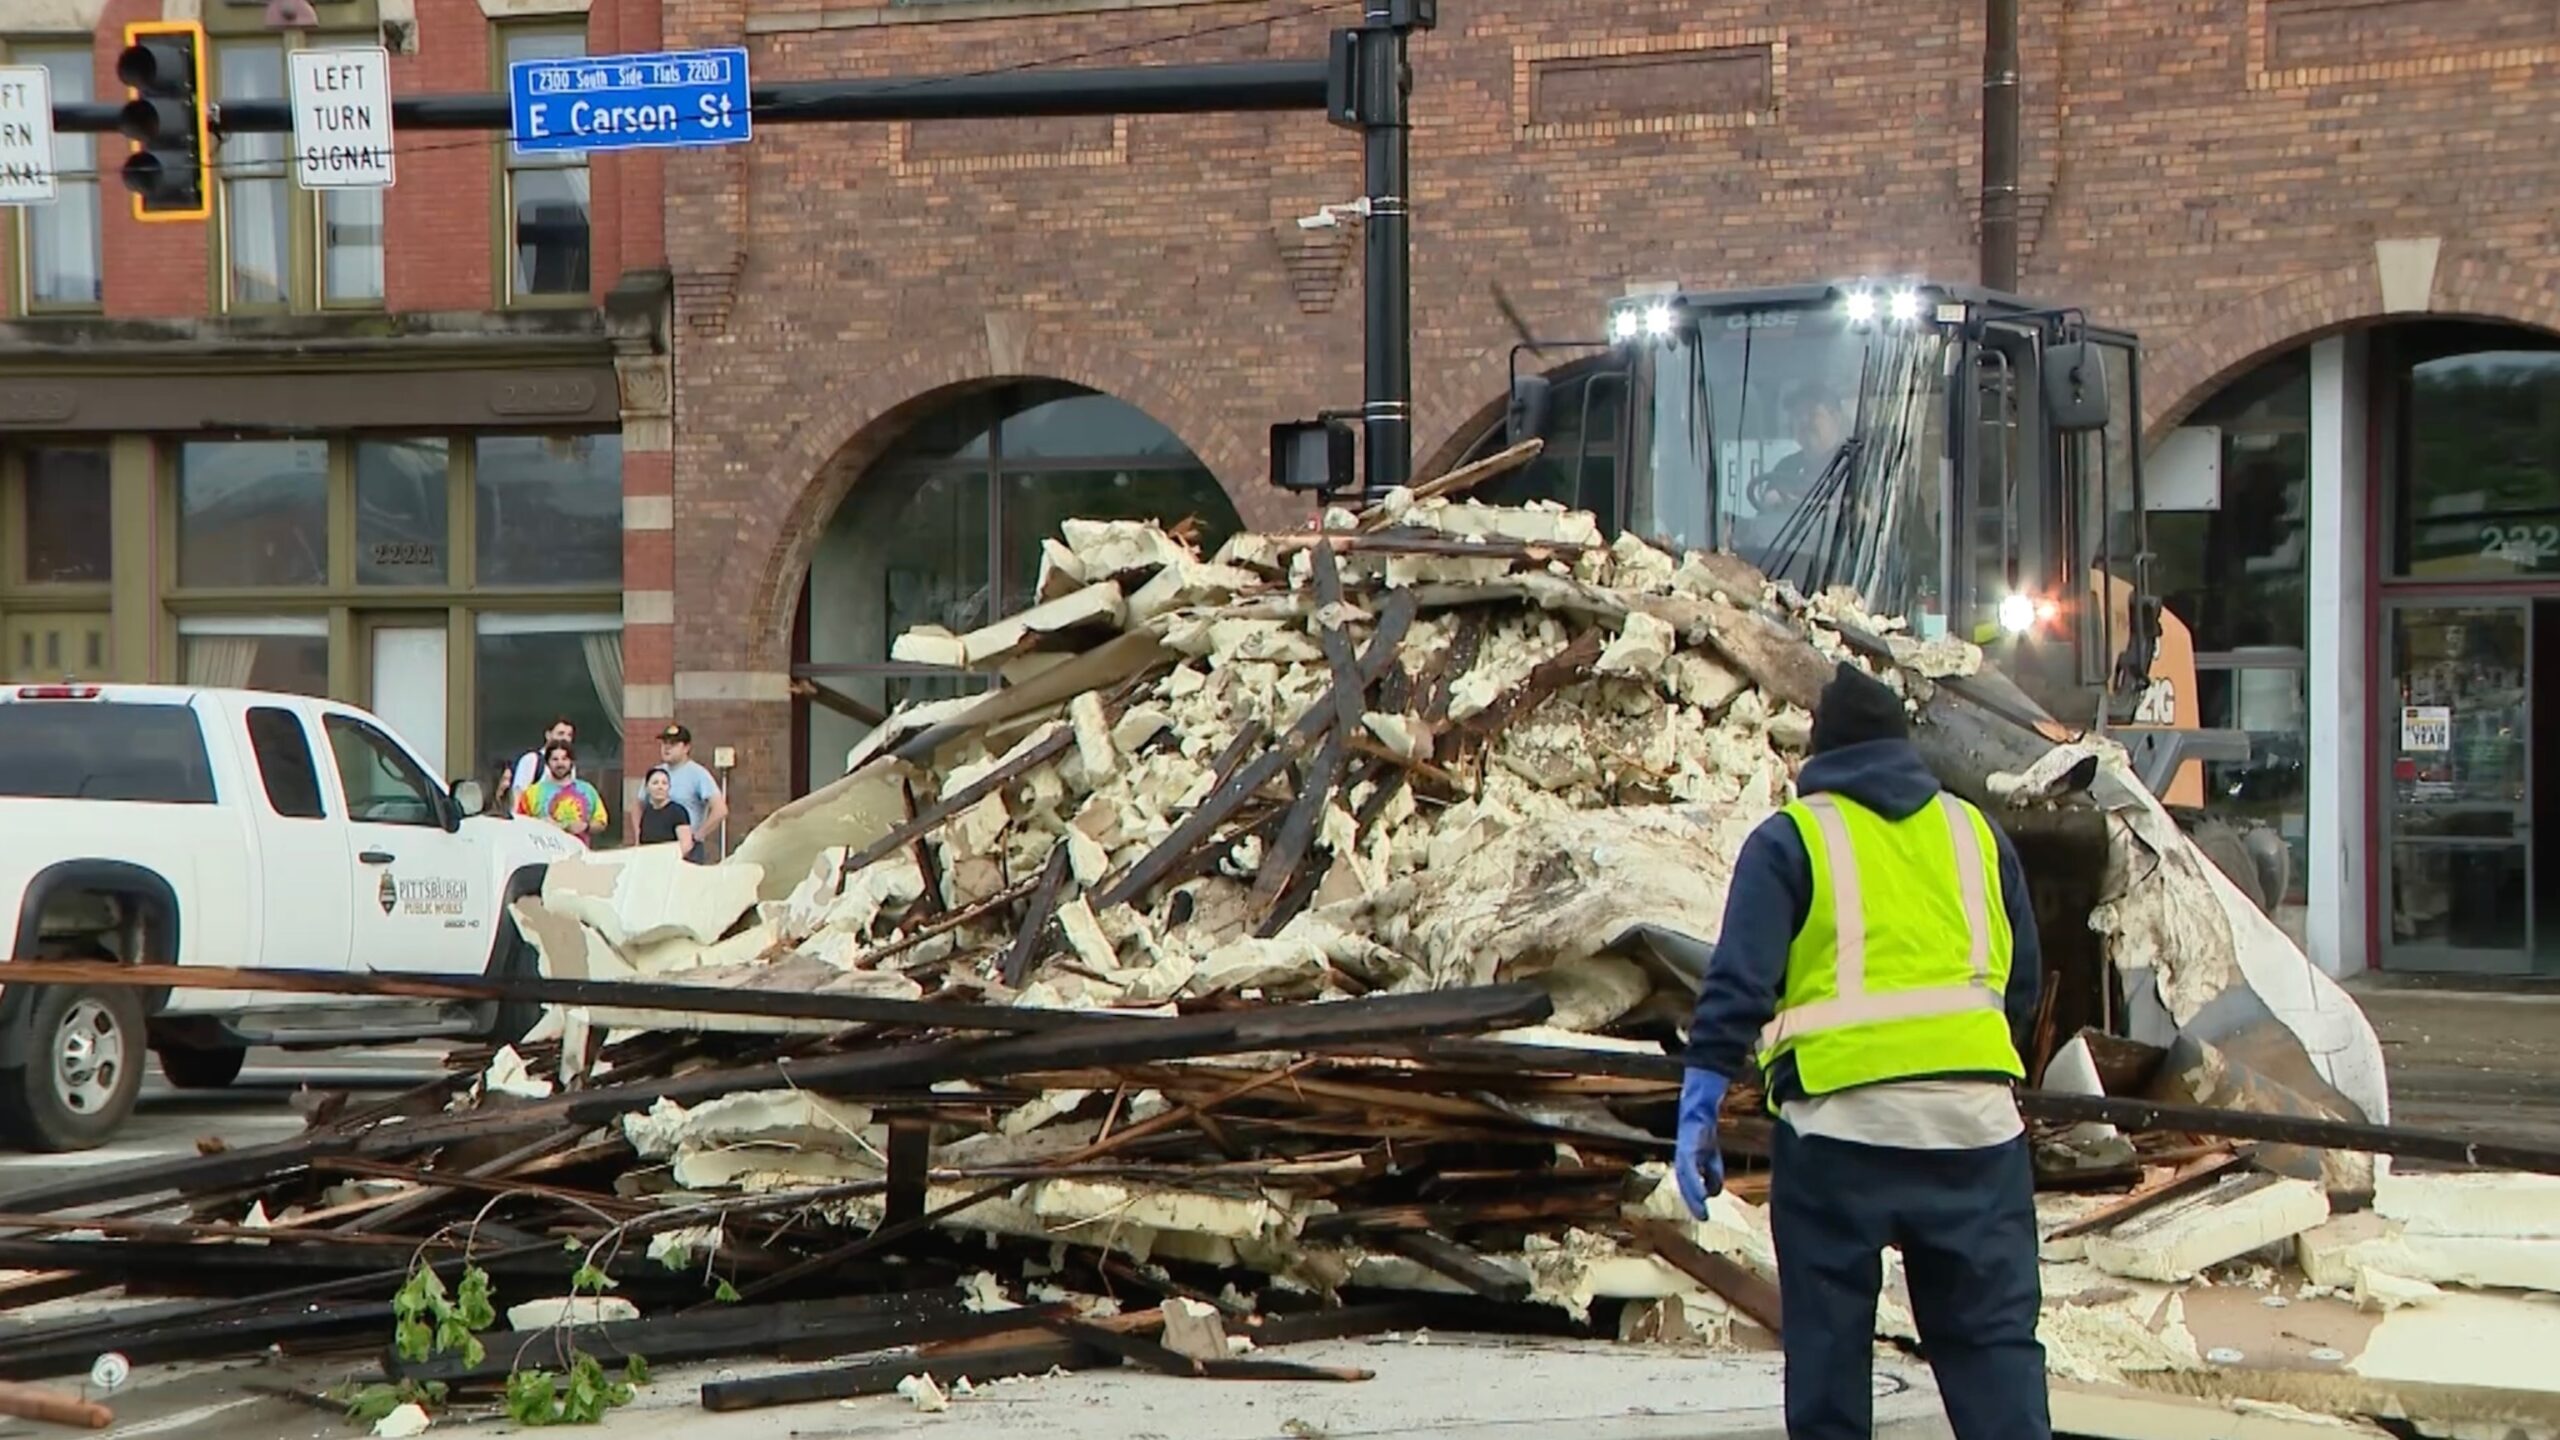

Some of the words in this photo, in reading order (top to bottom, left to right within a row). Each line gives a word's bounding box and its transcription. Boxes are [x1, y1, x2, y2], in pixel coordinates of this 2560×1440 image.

[313, 65, 364, 92] LEFT
[539, 73, 569, 91] 2300
[576, 69, 608, 88] South
[618, 67, 643, 86] Side
[653, 64, 680, 83] Flats
[687, 62, 718, 81] 2200
[2, 84, 27, 110] FT
[313, 105, 372, 131] TURN
[530, 103, 549, 137] E
[571, 100, 677, 136] Carson
[699, 92, 732, 128] St
[3, 122, 33, 147] RN
[307, 145, 386, 171] SIGNAL
[2412, 732, 2446, 745] YEAR
[400, 880, 468, 899] PITTSBURGH
